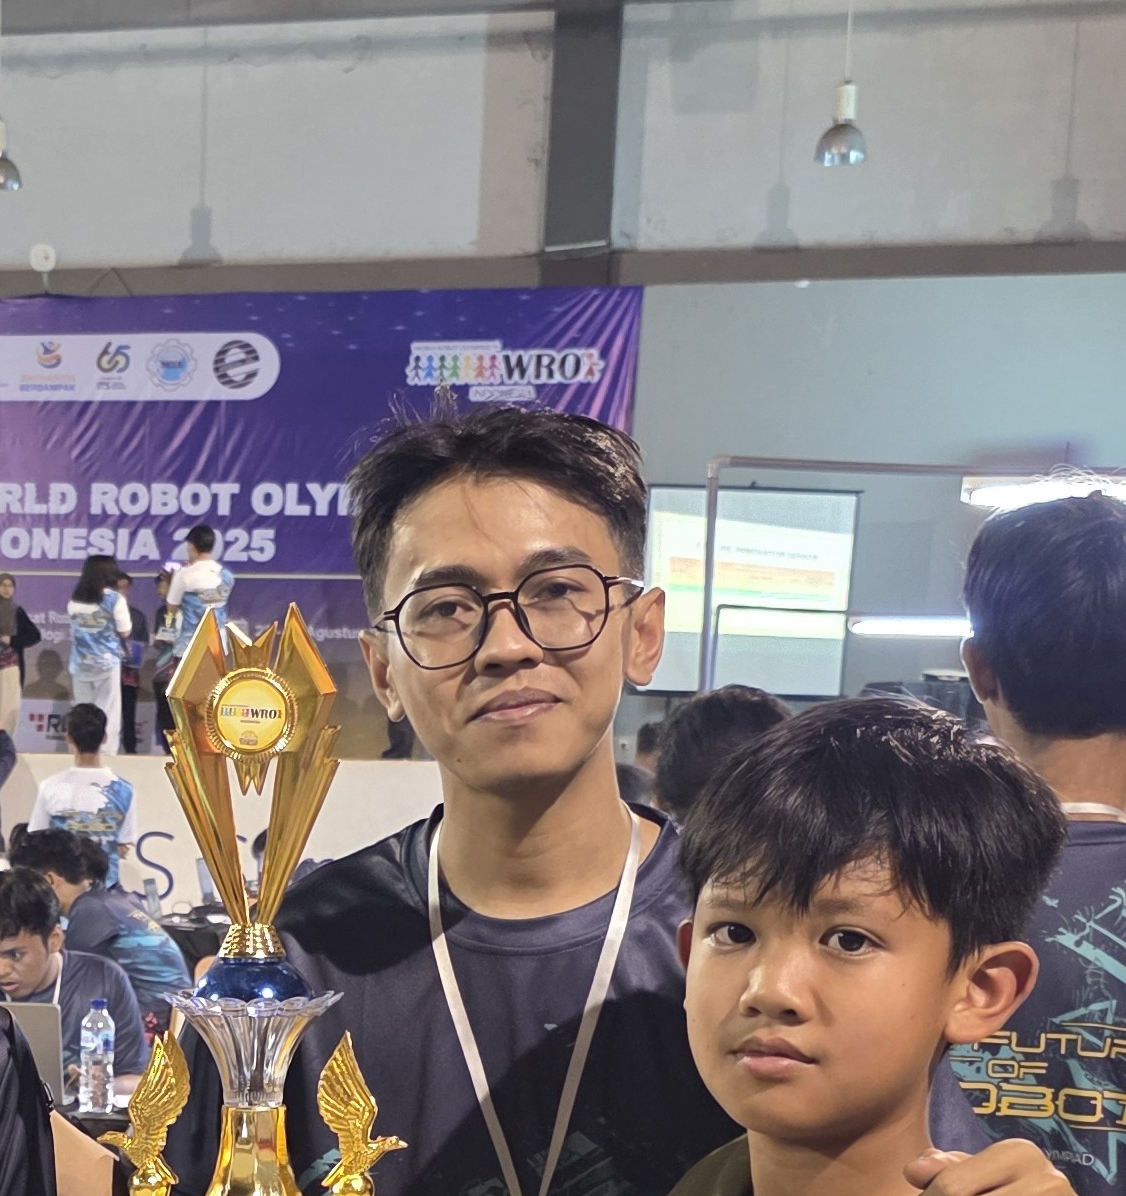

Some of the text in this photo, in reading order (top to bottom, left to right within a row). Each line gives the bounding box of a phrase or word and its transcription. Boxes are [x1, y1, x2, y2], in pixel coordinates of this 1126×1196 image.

[502, 352, 581, 381] WRO
[90, 482, 241, 516] ROBOT
[251, 708, 277, 720] WRO
[987, 1059, 1049, 1079] OF
